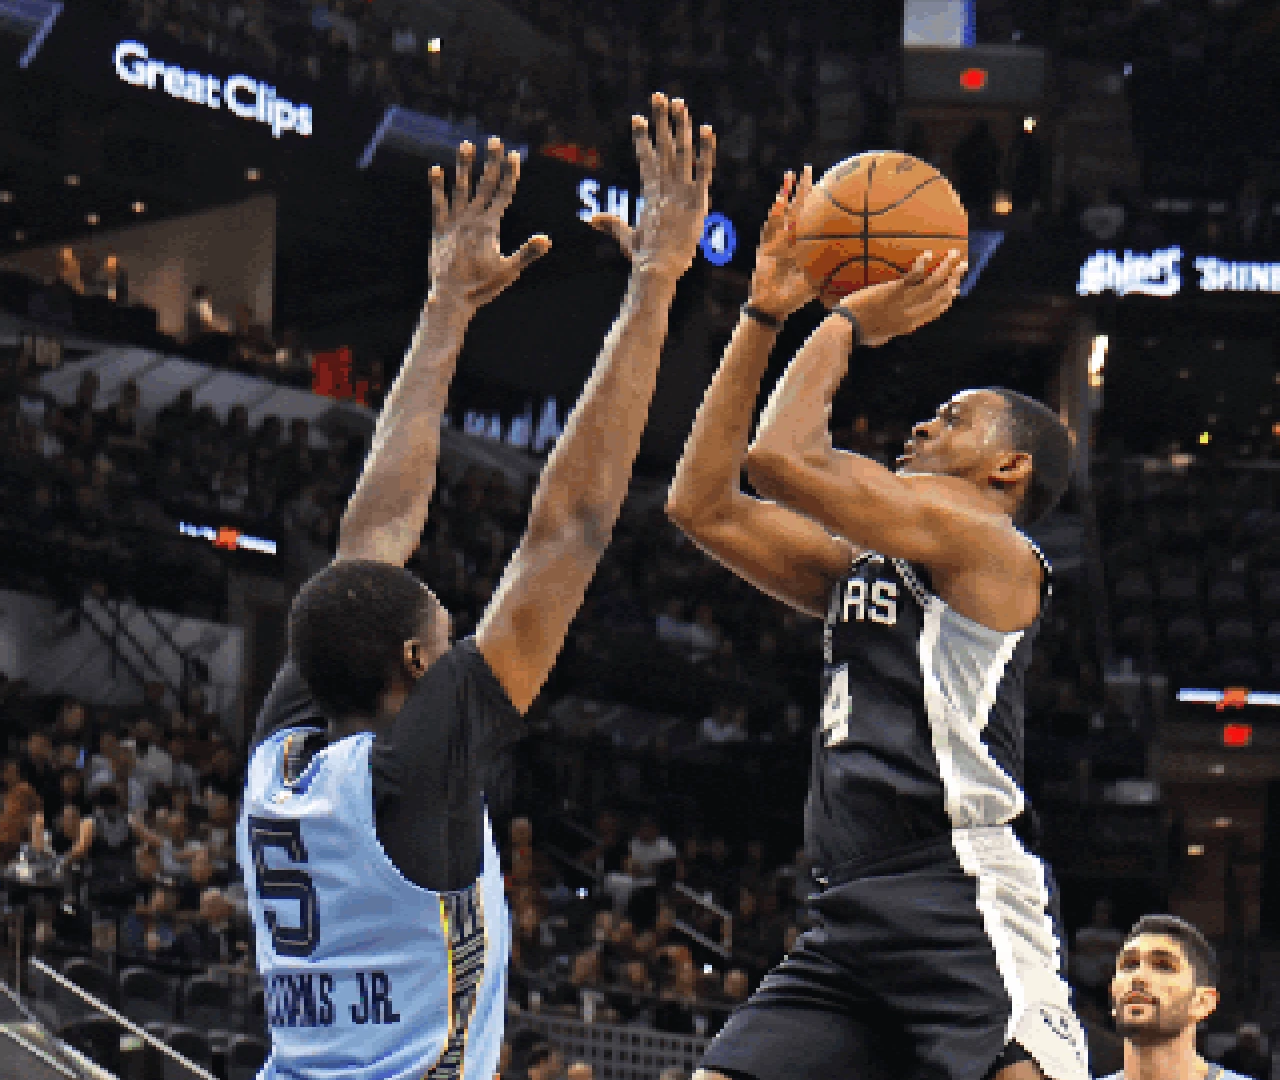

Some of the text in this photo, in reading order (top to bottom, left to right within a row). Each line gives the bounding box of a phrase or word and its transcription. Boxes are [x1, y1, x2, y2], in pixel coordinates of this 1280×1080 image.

[113, 40, 312, 140] Great Clips
[248, 815, 320, 958] 5
